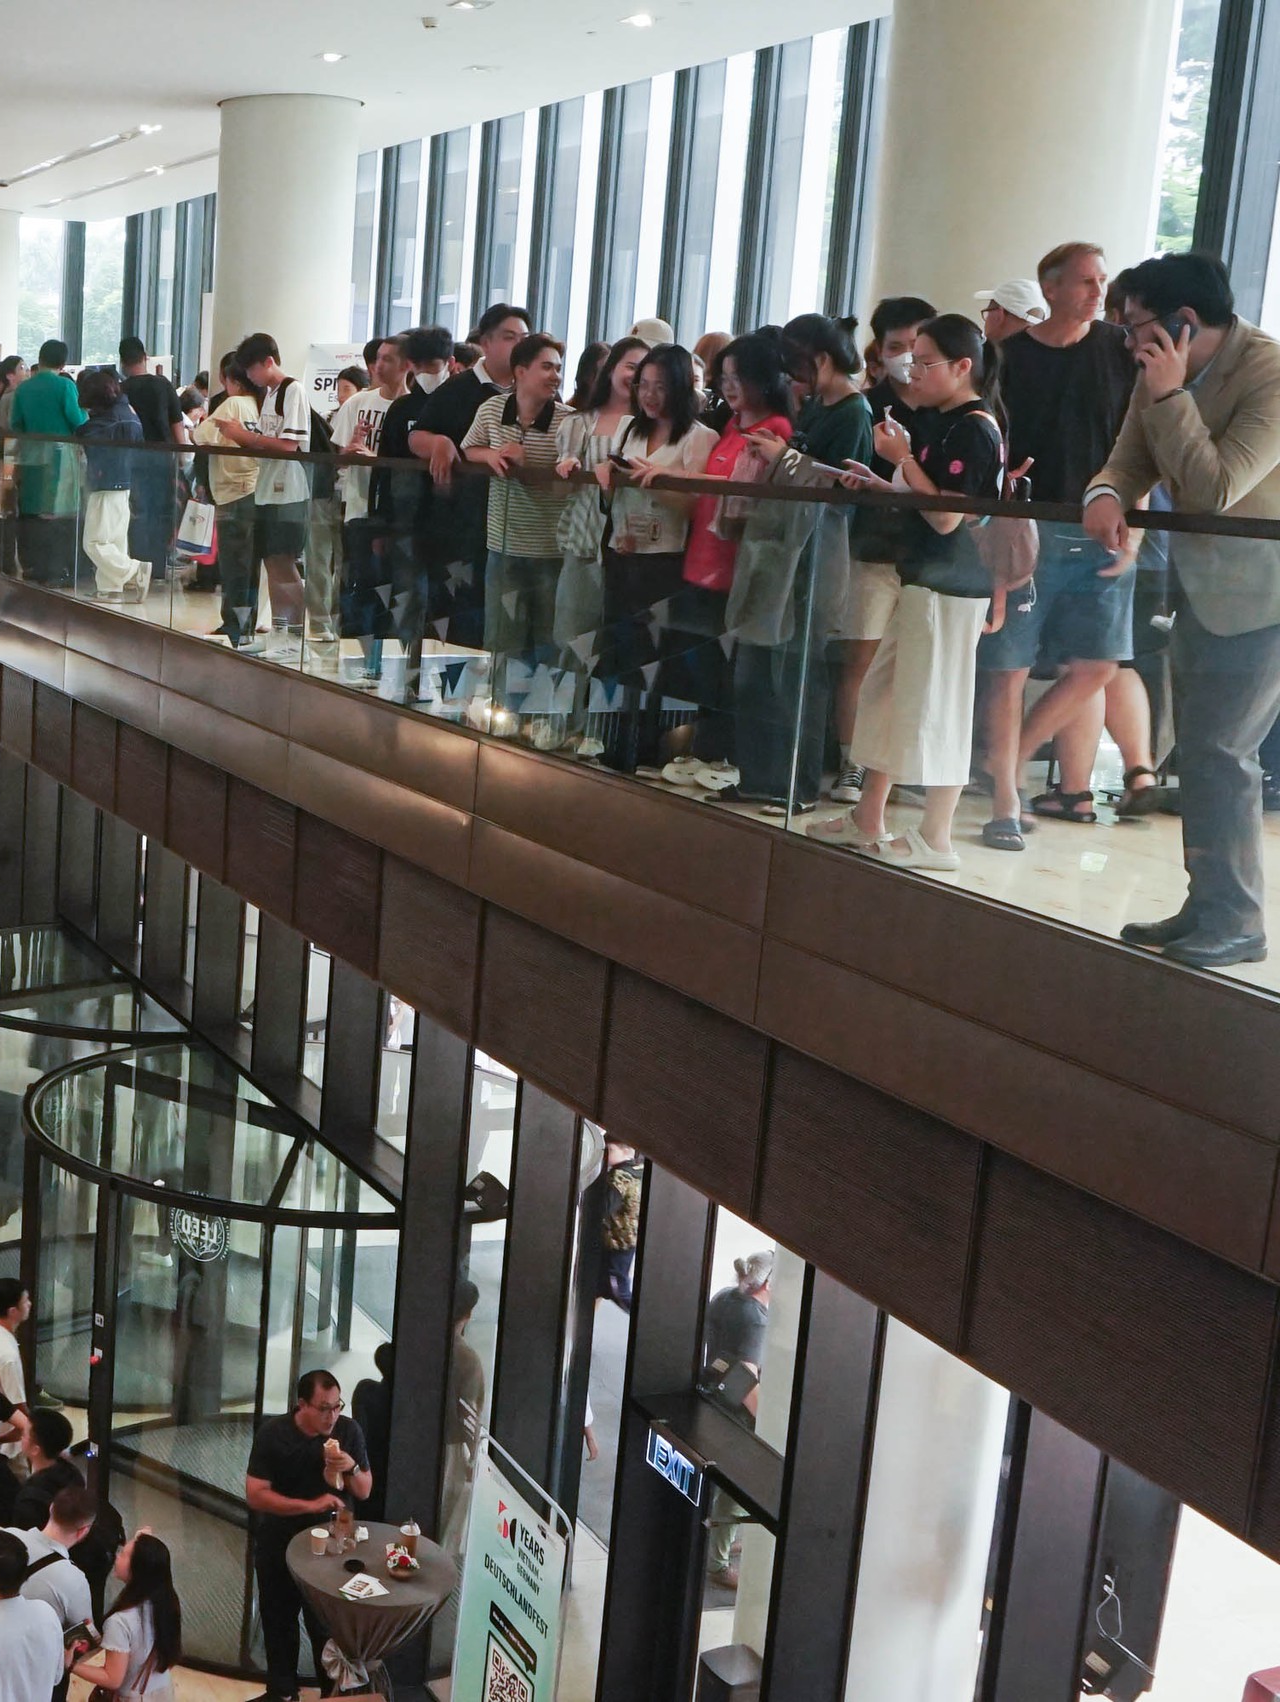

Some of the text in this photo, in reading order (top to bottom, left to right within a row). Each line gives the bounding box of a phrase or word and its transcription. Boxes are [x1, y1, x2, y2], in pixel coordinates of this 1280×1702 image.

[653, 1433, 695, 1495] EXIT
[518, 1547, 539, 1579] VIETNAM
[520, 1523, 545, 1566] YEARS
[484, 1553, 549, 1639] DEUTSCHLANDFEST
[516, 1562, 540, 1596] GERMANY
